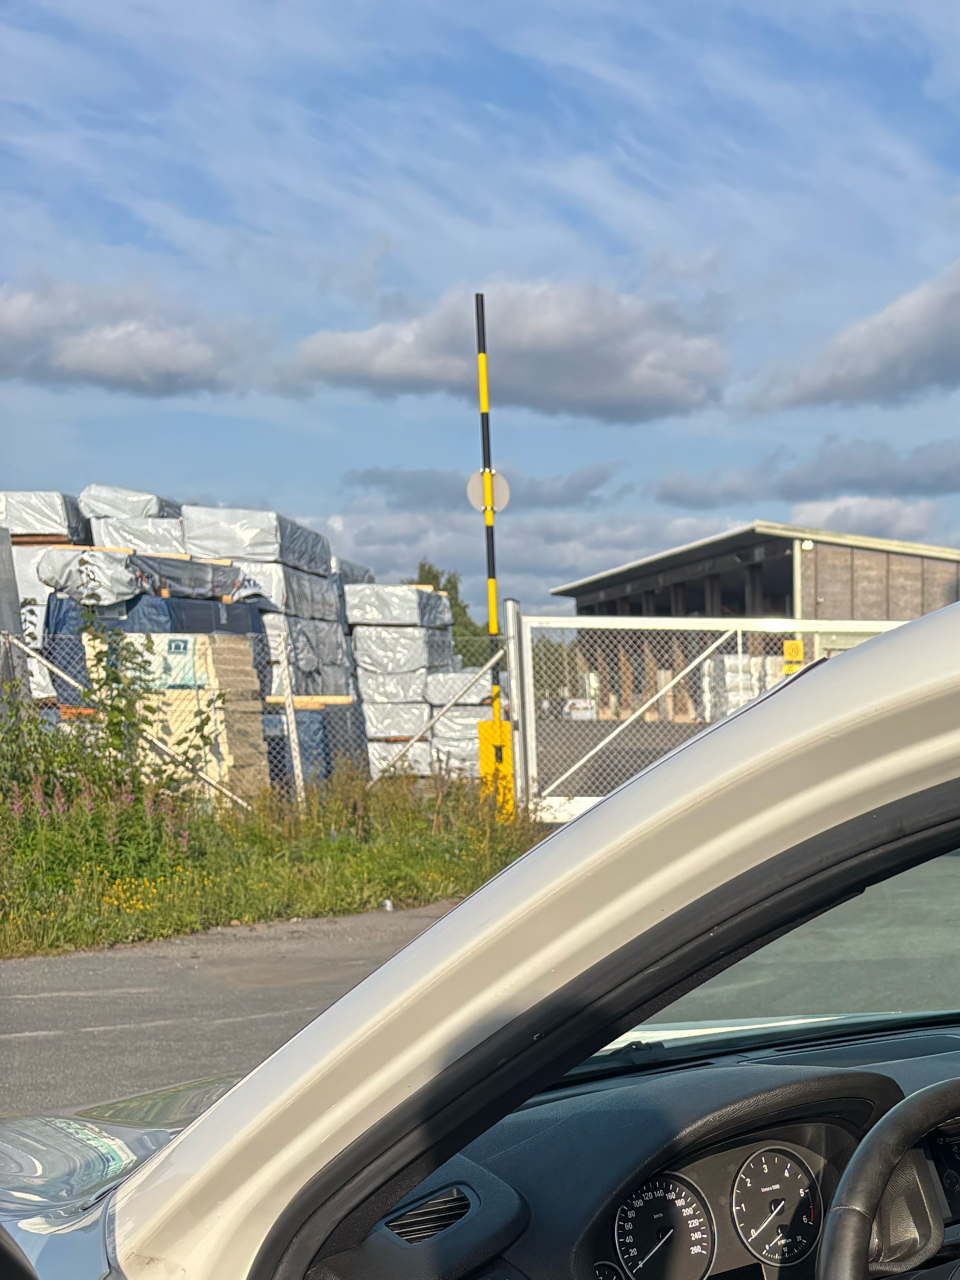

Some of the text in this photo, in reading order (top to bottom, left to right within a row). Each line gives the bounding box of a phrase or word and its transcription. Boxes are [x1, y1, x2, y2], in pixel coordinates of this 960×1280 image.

[762, 1164, 768, 1173] 3
[784, 1169, 789, 1177] 4
[746, 1178, 752, 1187] 2
[642, 1192, 653, 1200] 120
[654, 1189, 664, 1197] 140
[665, 1192, 676, 1200] 160
[799, 1188, 805, 1197] 5
[632, 1199, 643, 1208] 100
[741, 1203, 746, 1212] 1
[627, 1210, 636, 1218] 80
[681, 1207, 693, 1216] 200
[687, 1219, 699, 1228] 220
[802, 1215, 808, 1223] 6
[624, 1222, 633, 1230] 60
[625, 1235, 634, 1243] 40
[690, 1231, 702, 1240] 240
[628, 1247, 638, 1256] 20
[689, 1245, 701, 1254] 260
